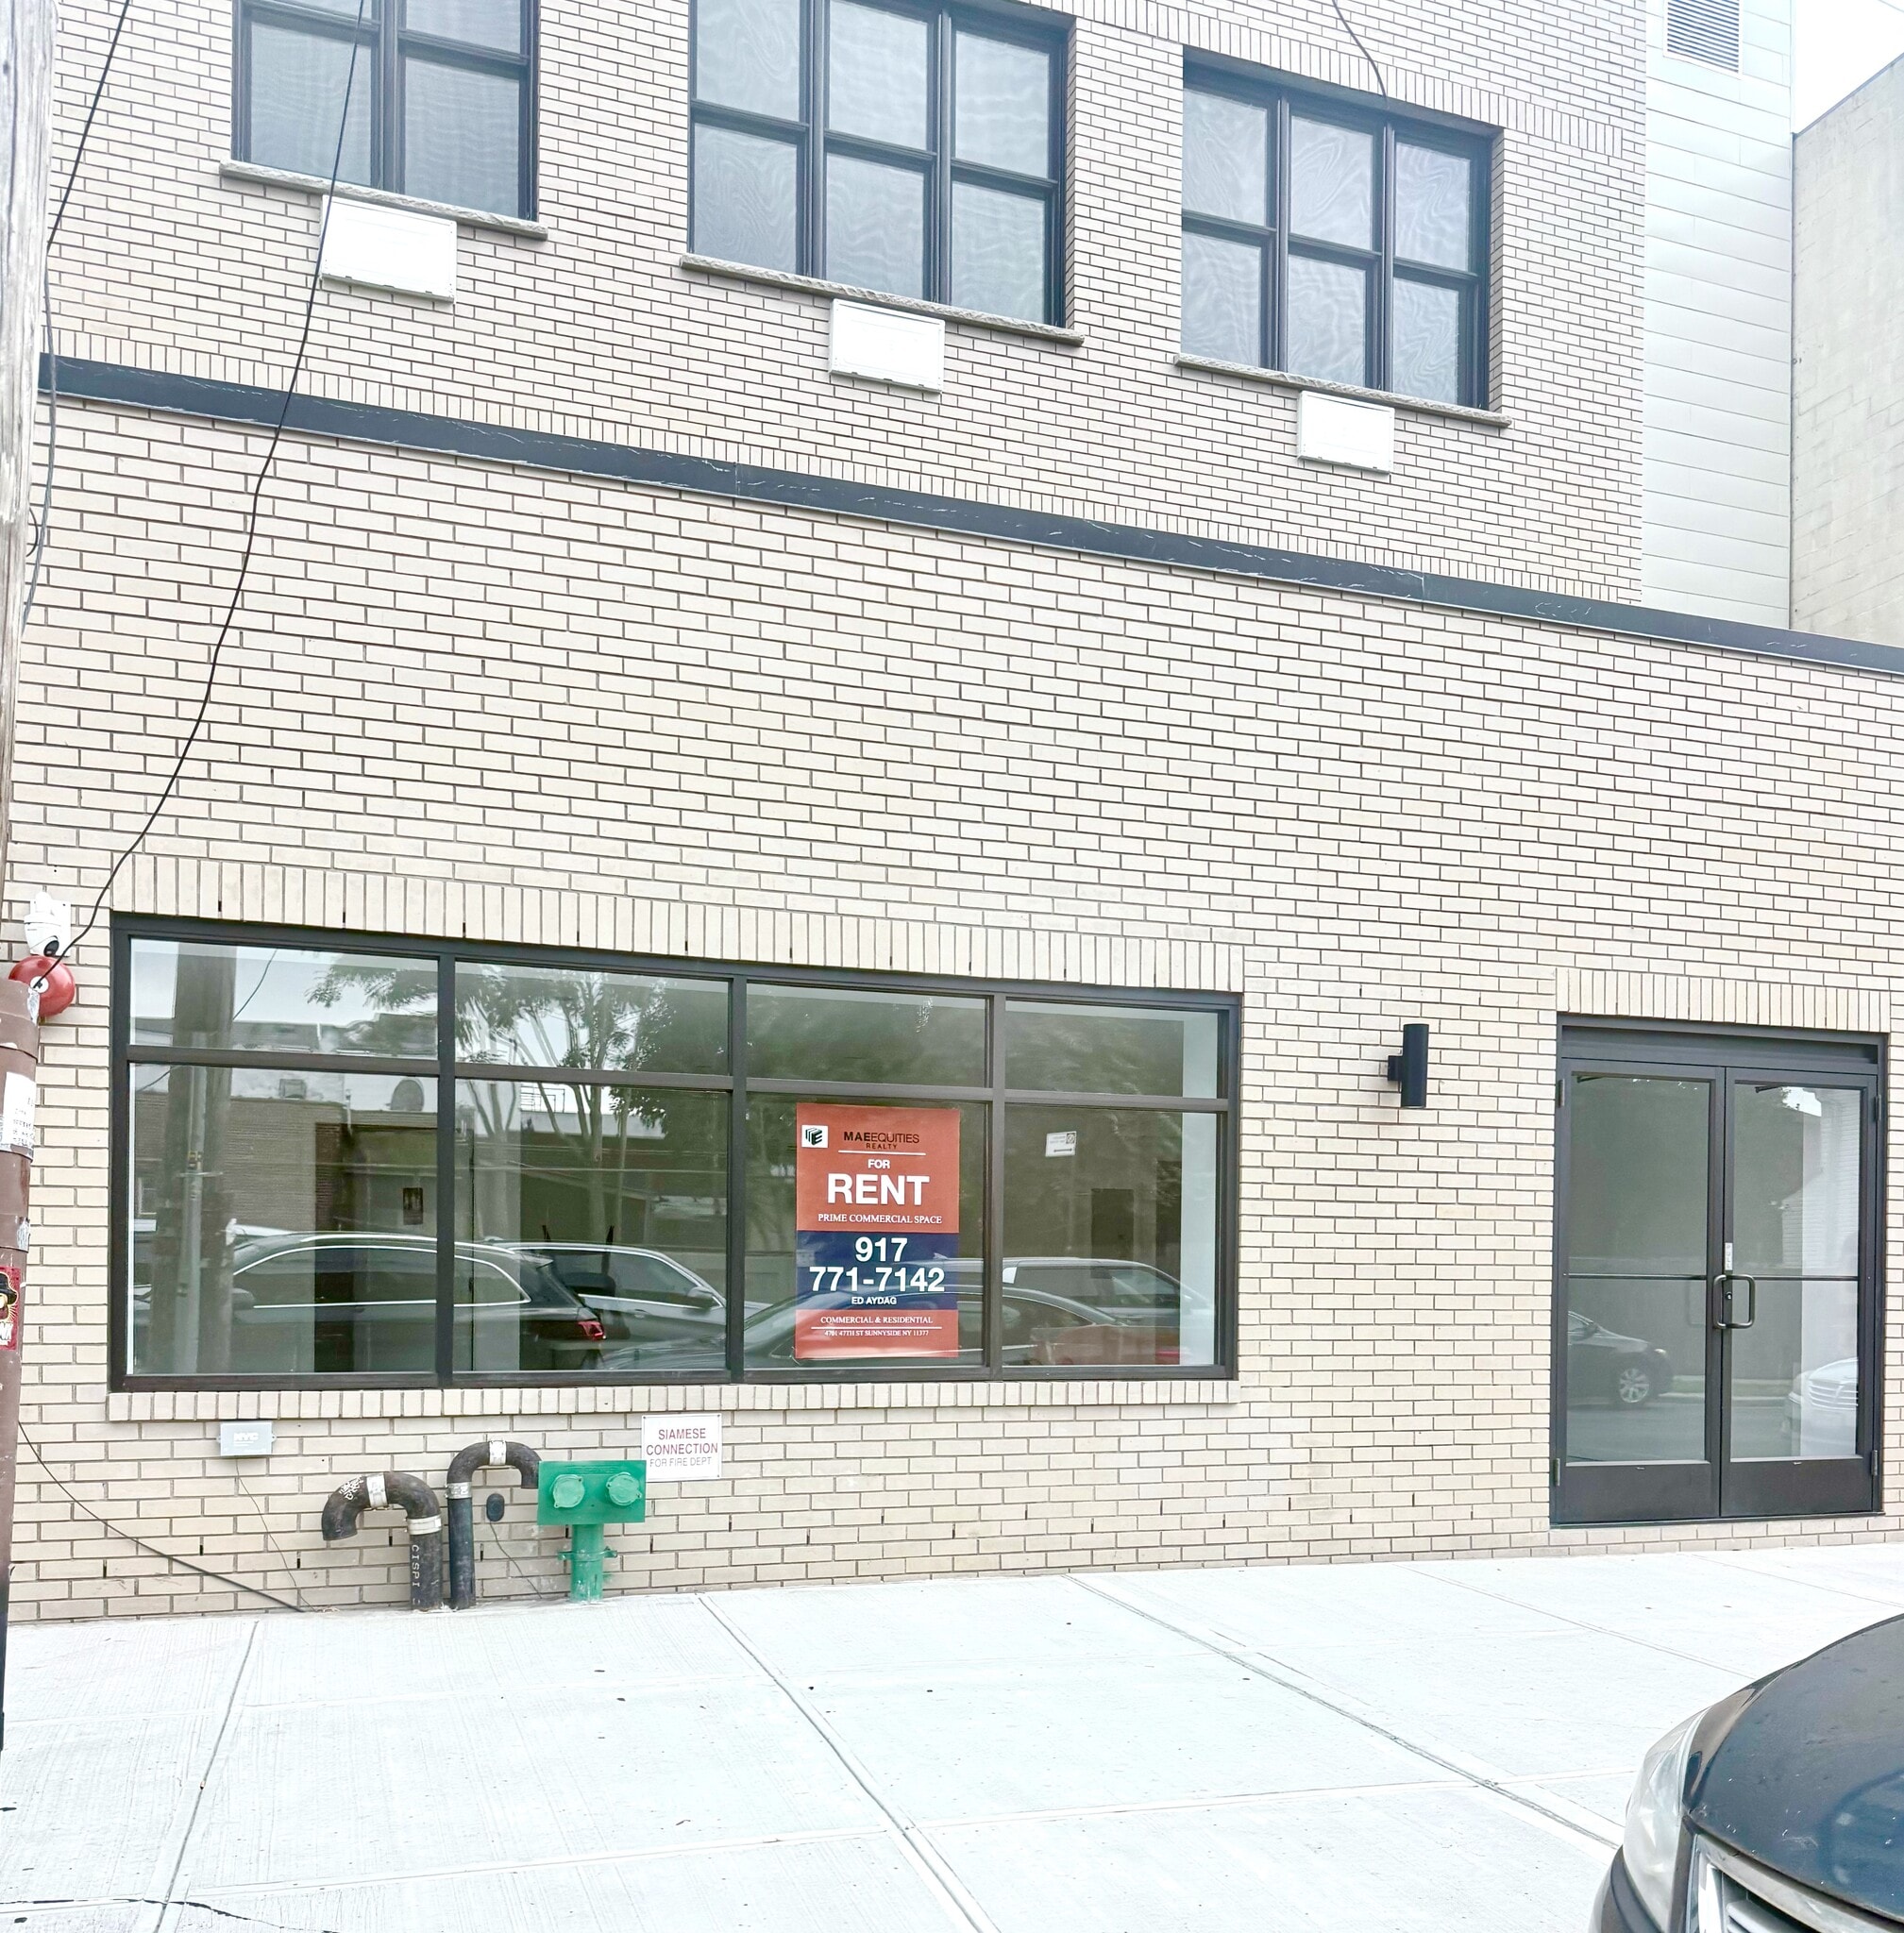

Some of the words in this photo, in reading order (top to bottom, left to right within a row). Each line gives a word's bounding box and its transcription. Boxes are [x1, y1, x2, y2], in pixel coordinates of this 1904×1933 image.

[868, 1159, 890, 1168] FOR
[827, 1173, 930, 1205] RENT
[850, 1215, 912, 1223] COMMERCIAL
[854, 1236, 908, 1262] 917
[809, 1267, 945, 1292] 771-7142
[233, 1432, 259, 1440] NYC
[658, 1428, 706, 1440] SIAMESE
[646, 1443, 718, 1455] CONNECTION
[649, 1458, 667, 1468] FOR
[669, 1457, 688, 1467] FIRE
[690, 1456, 712, 1466] DEPT
[412, 1544, 421, 1588] CISPI
